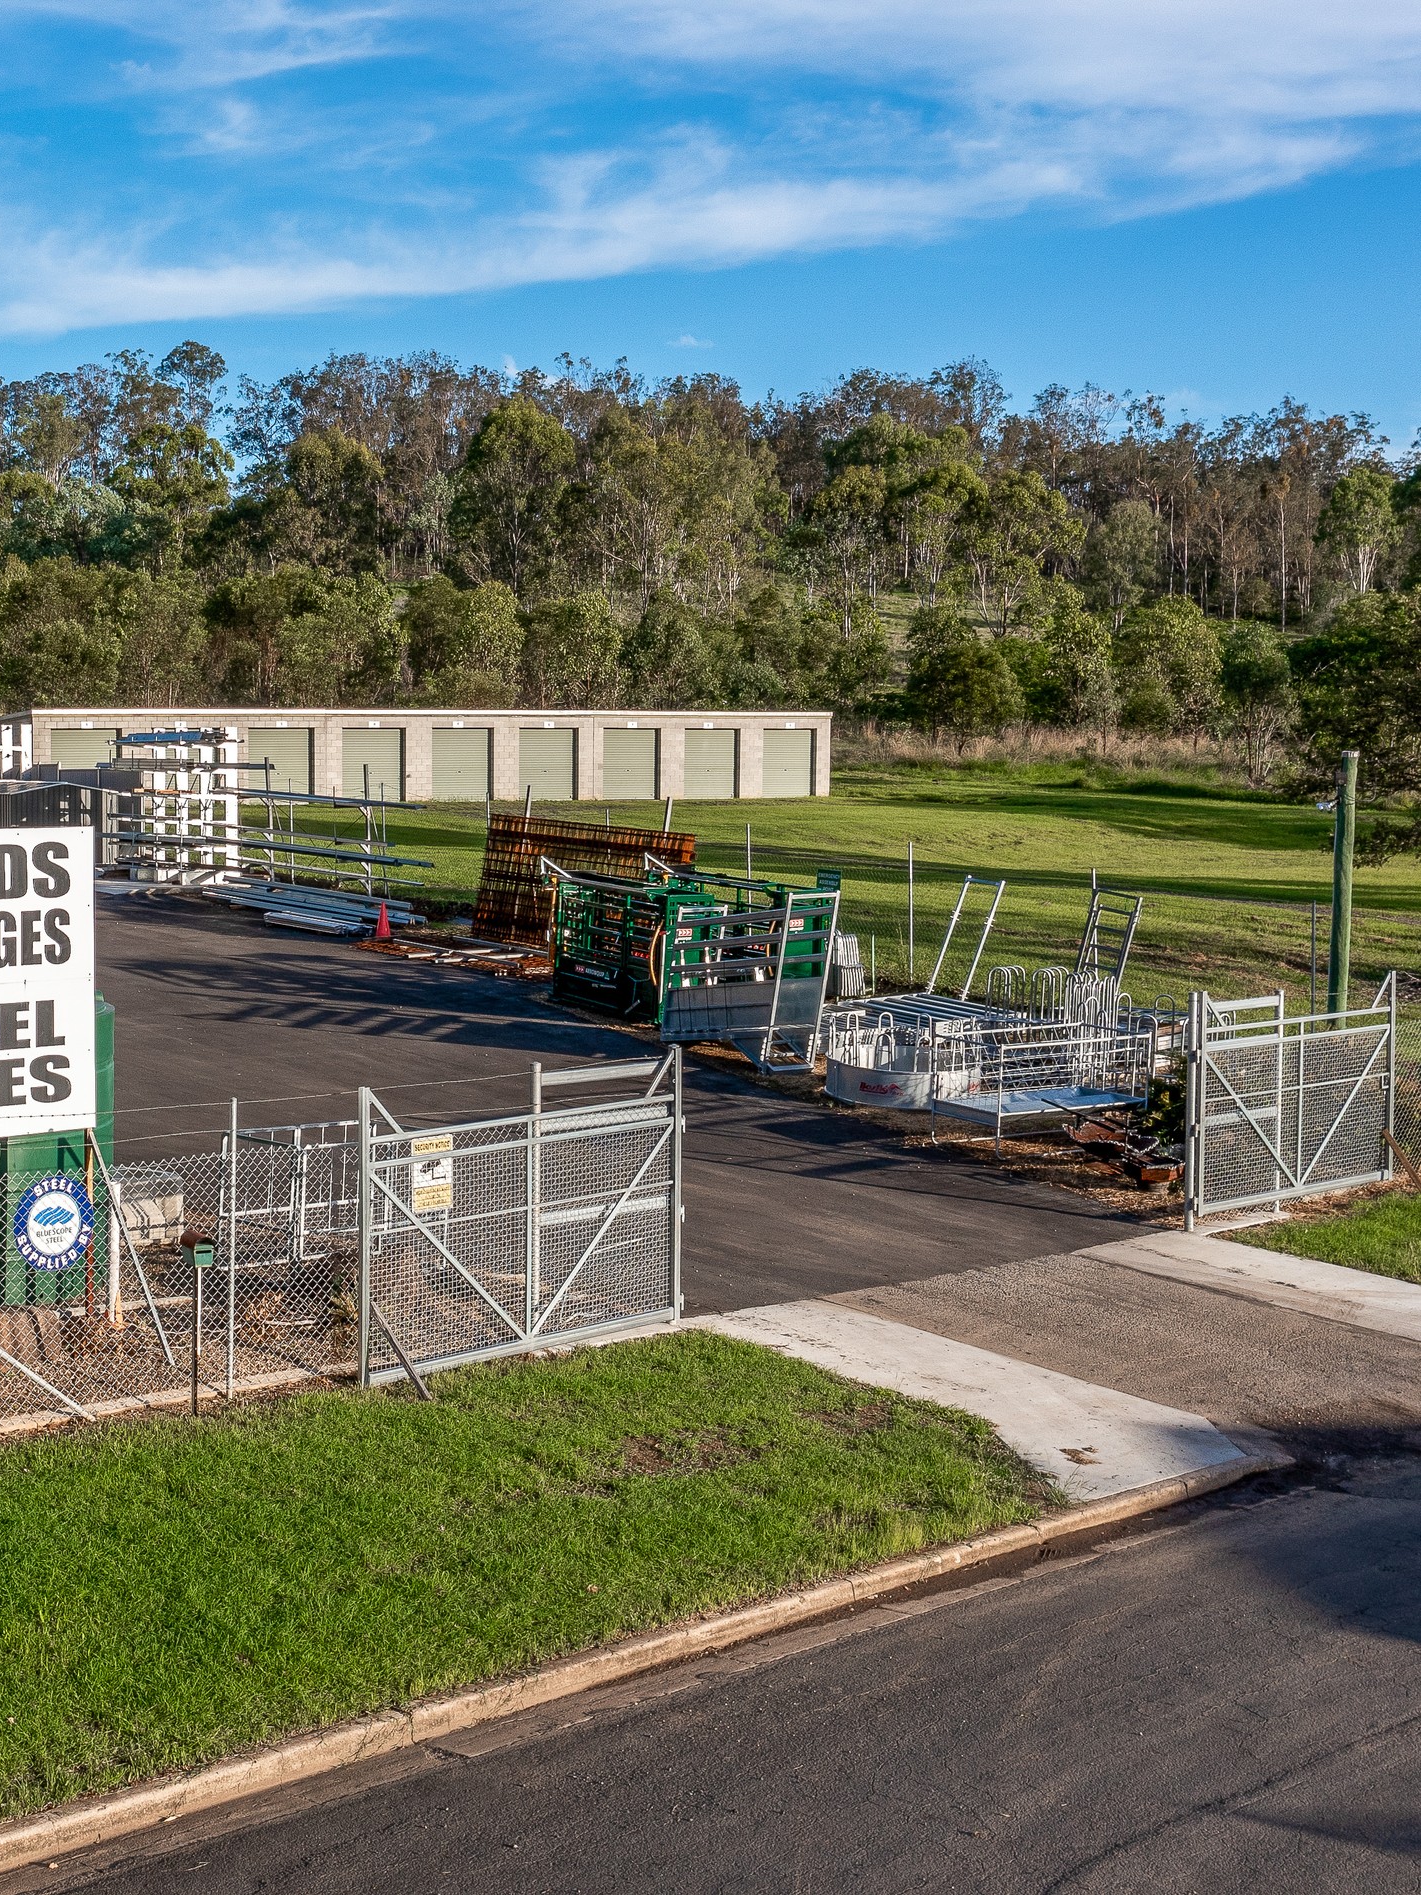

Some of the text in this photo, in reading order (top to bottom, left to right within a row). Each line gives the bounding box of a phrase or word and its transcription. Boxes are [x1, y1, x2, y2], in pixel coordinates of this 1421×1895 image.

[414, 1142, 435, 1152] SECURITY
[33, 1178, 74, 1197] STEEL
[36, 1226, 73, 1238] BLUESCOPE
[17, 1223, 92, 1269] SUPPLIED BY
[45, 1237, 64, 1245] STEEL
